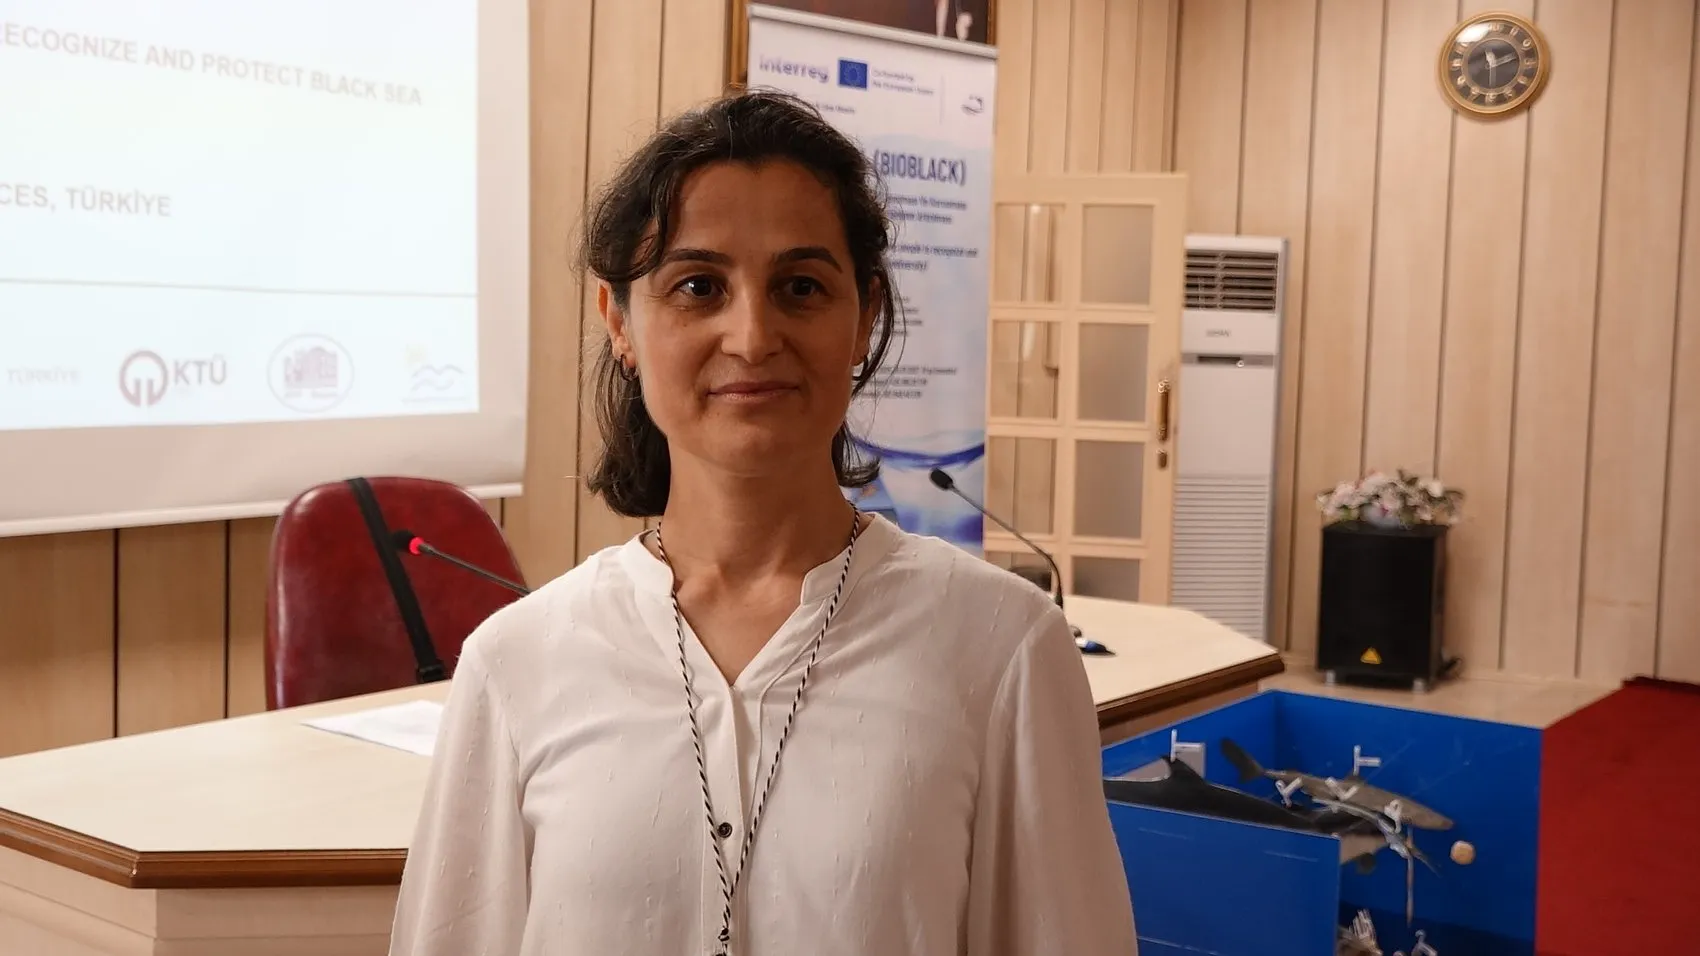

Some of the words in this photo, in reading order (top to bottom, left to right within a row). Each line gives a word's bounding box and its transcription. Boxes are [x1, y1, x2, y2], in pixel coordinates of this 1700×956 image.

[145, 44, 195, 72] AND
[201, 52, 305, 89] PROTECT
[309, 70, 378, 100] BLACK
[383, 83, 423, 107] SEA
[874, 149, 966, 186] (BIOBLACK)
[65, 184, 173, 217] TÜRKİYE
[174, 353, 227, 386] KTÜ
